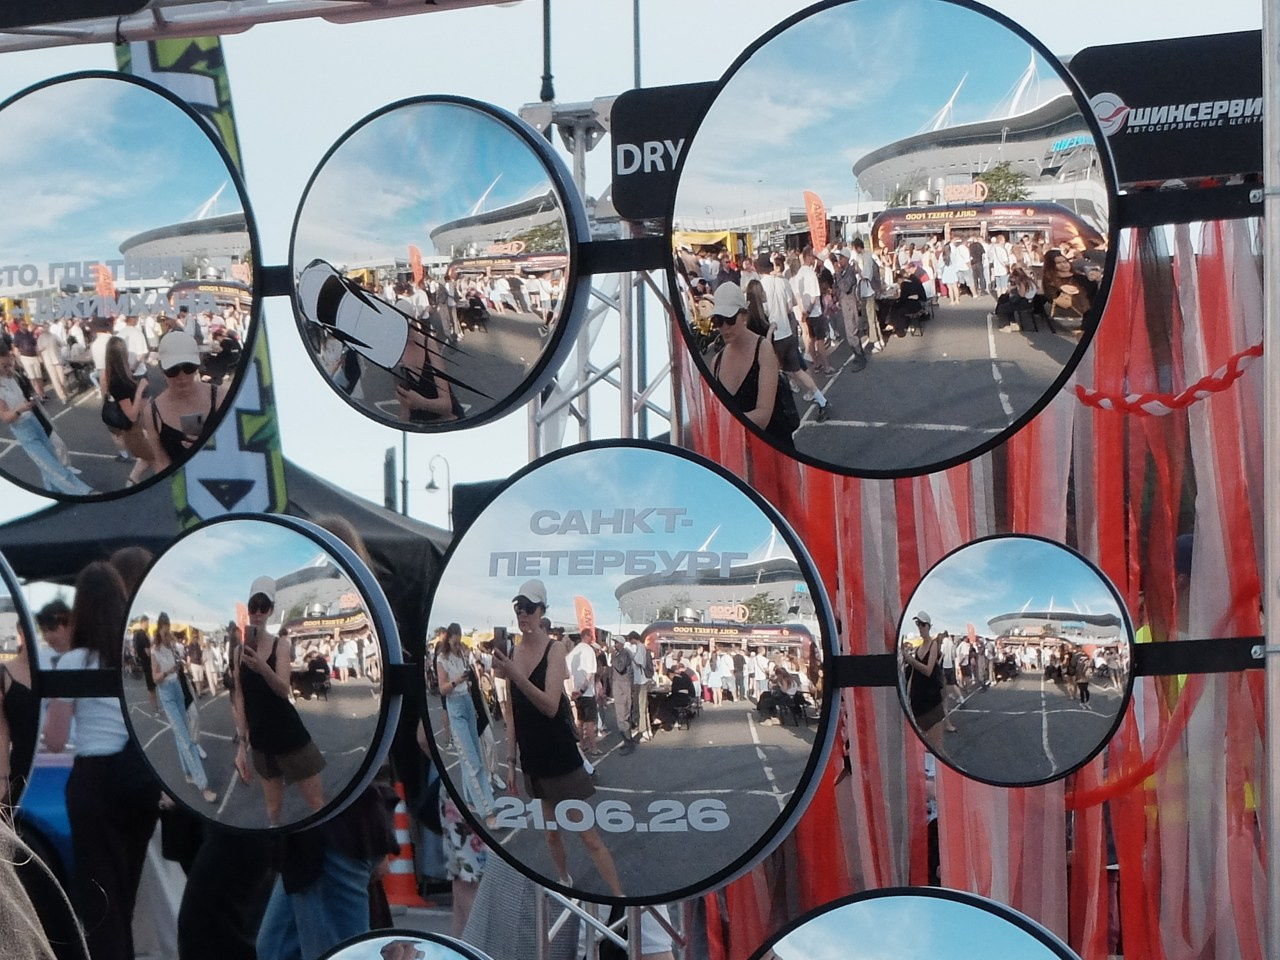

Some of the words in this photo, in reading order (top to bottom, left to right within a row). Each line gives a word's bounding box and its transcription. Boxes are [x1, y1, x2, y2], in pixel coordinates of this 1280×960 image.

[1127, 98, 1263, 126] ШИНСЕРВИ
[1126, 120, 1223, 134] АВТОСЕРВИСНЫЕ
[616, 138, 686, 175] DRY
[529, 507, 694, 536] САНКТ-
[488, 550, 749, 579] ПЕТЕРБУРГ
[495, 797, 731, 833] 21.06.26
